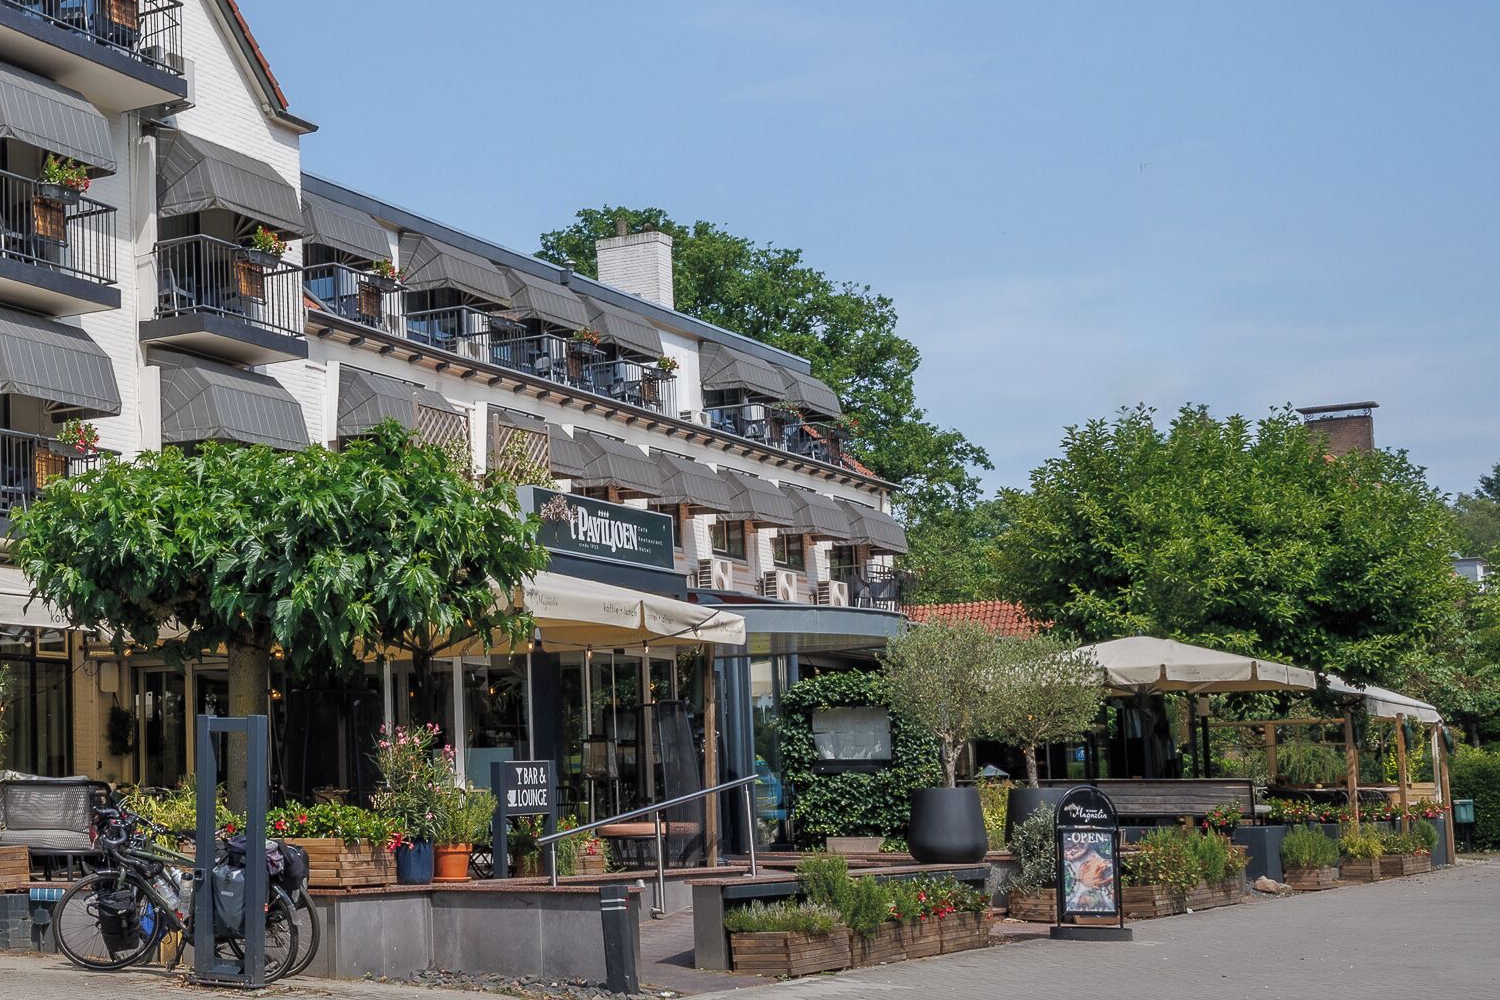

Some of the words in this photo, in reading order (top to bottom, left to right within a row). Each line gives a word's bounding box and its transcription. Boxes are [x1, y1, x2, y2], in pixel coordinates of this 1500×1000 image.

[523, 766, 539, 785] BAR
[539, 766, 547, 784] &
[517, 788, 548, 807] LOUNGE
